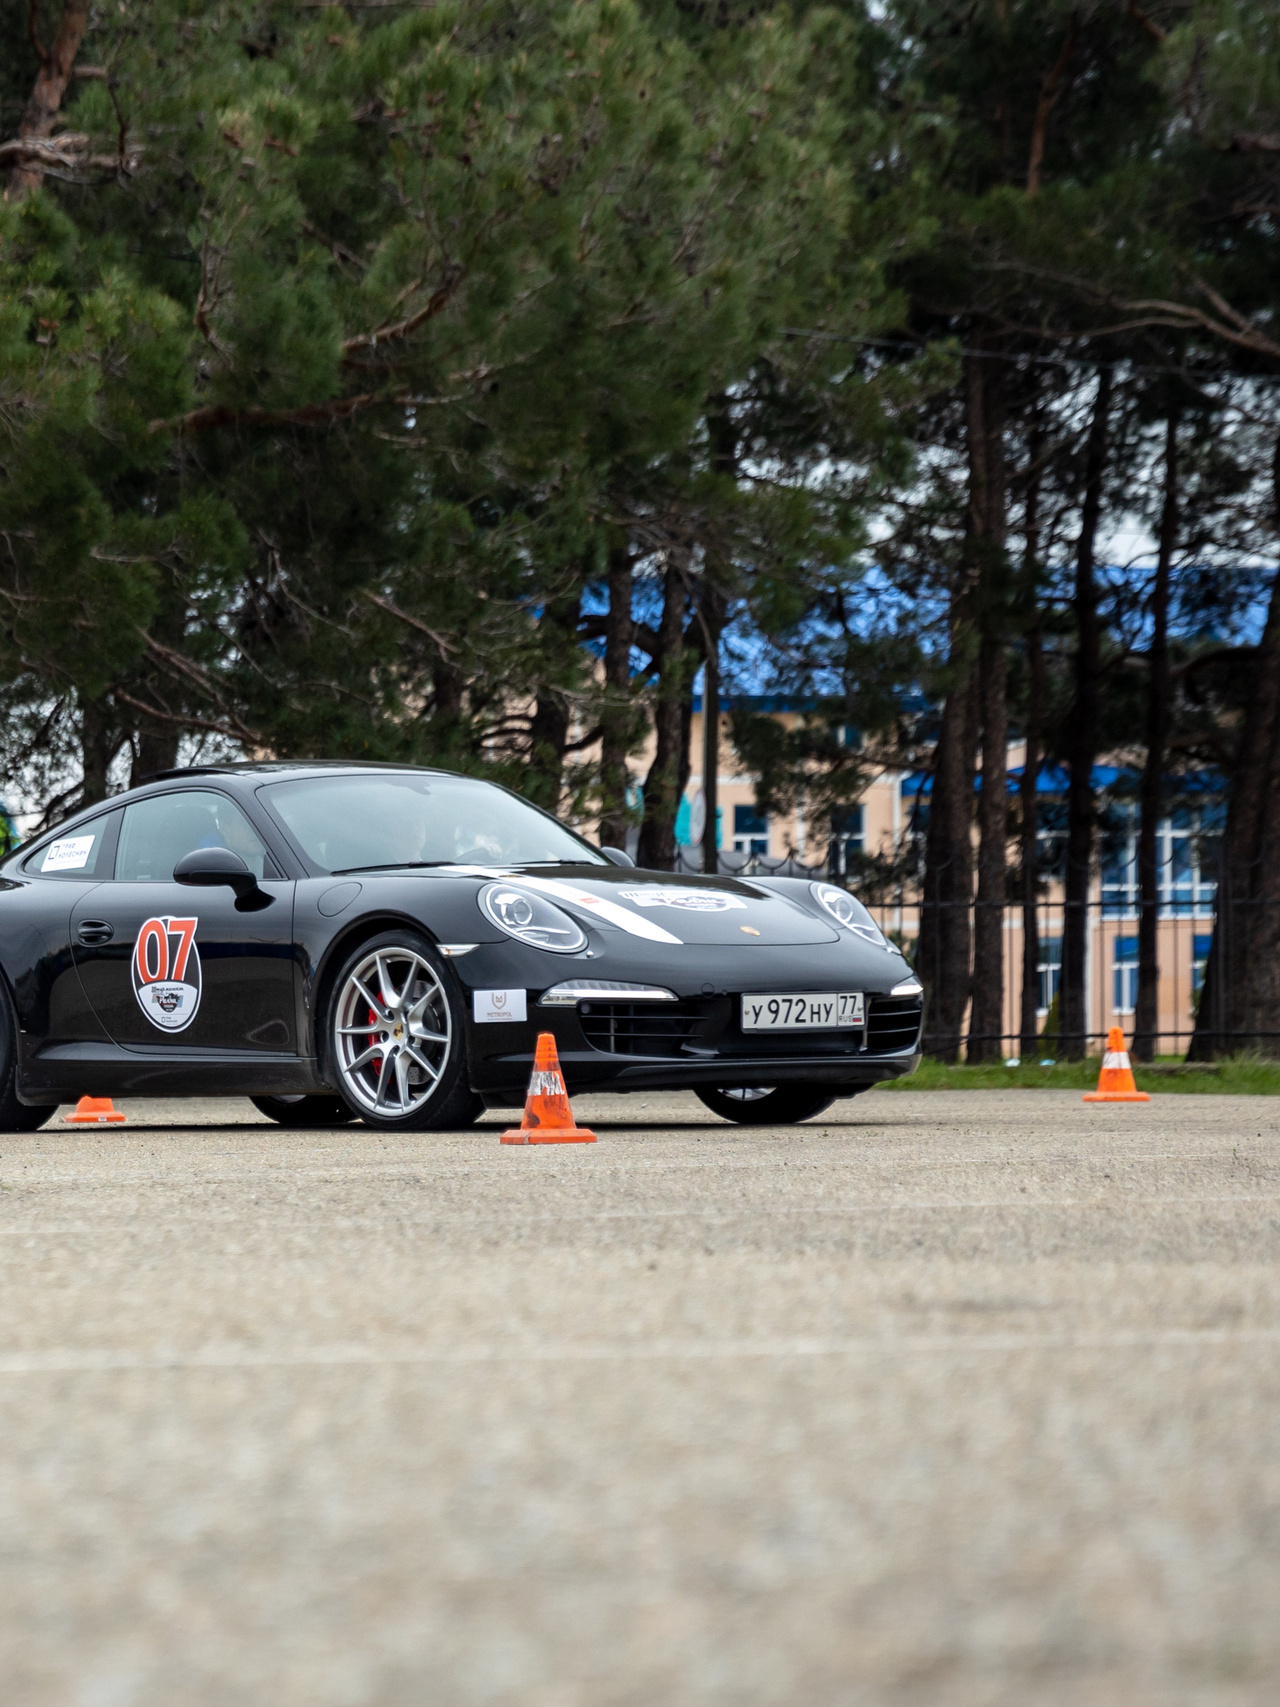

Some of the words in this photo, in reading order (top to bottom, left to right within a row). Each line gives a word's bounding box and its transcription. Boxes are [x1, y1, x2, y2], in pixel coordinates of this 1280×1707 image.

[136, 917, 198, 984] 07
[839, 995, 857, 1015] 77
[838, 1015, 853, 1023] RUS
